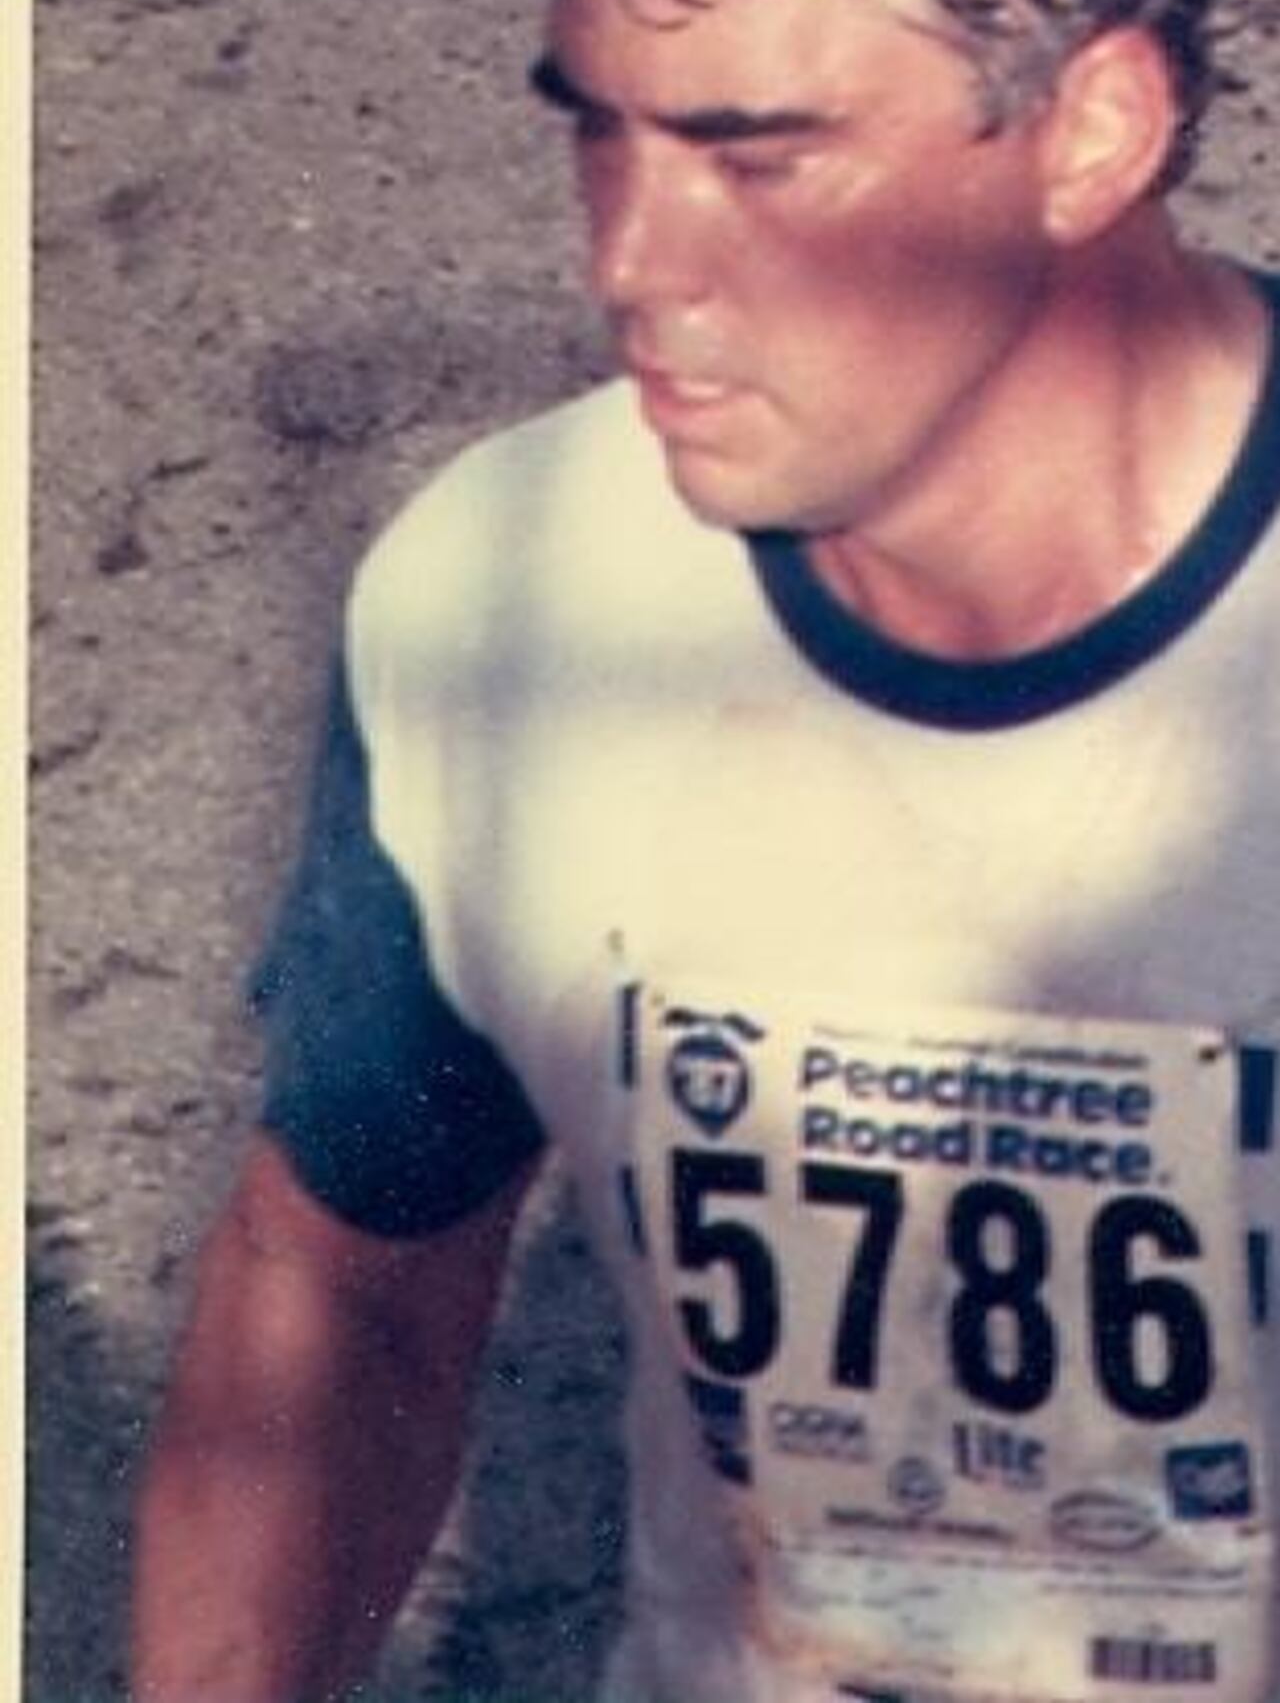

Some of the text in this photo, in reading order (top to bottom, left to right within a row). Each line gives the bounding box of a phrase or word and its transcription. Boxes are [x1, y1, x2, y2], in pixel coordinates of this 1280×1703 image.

[801, 1048, 1154, 1127] Peachtree
[801, 1106, 973, 1165] Road
[670, 1148, 1217, 1423] 5786
